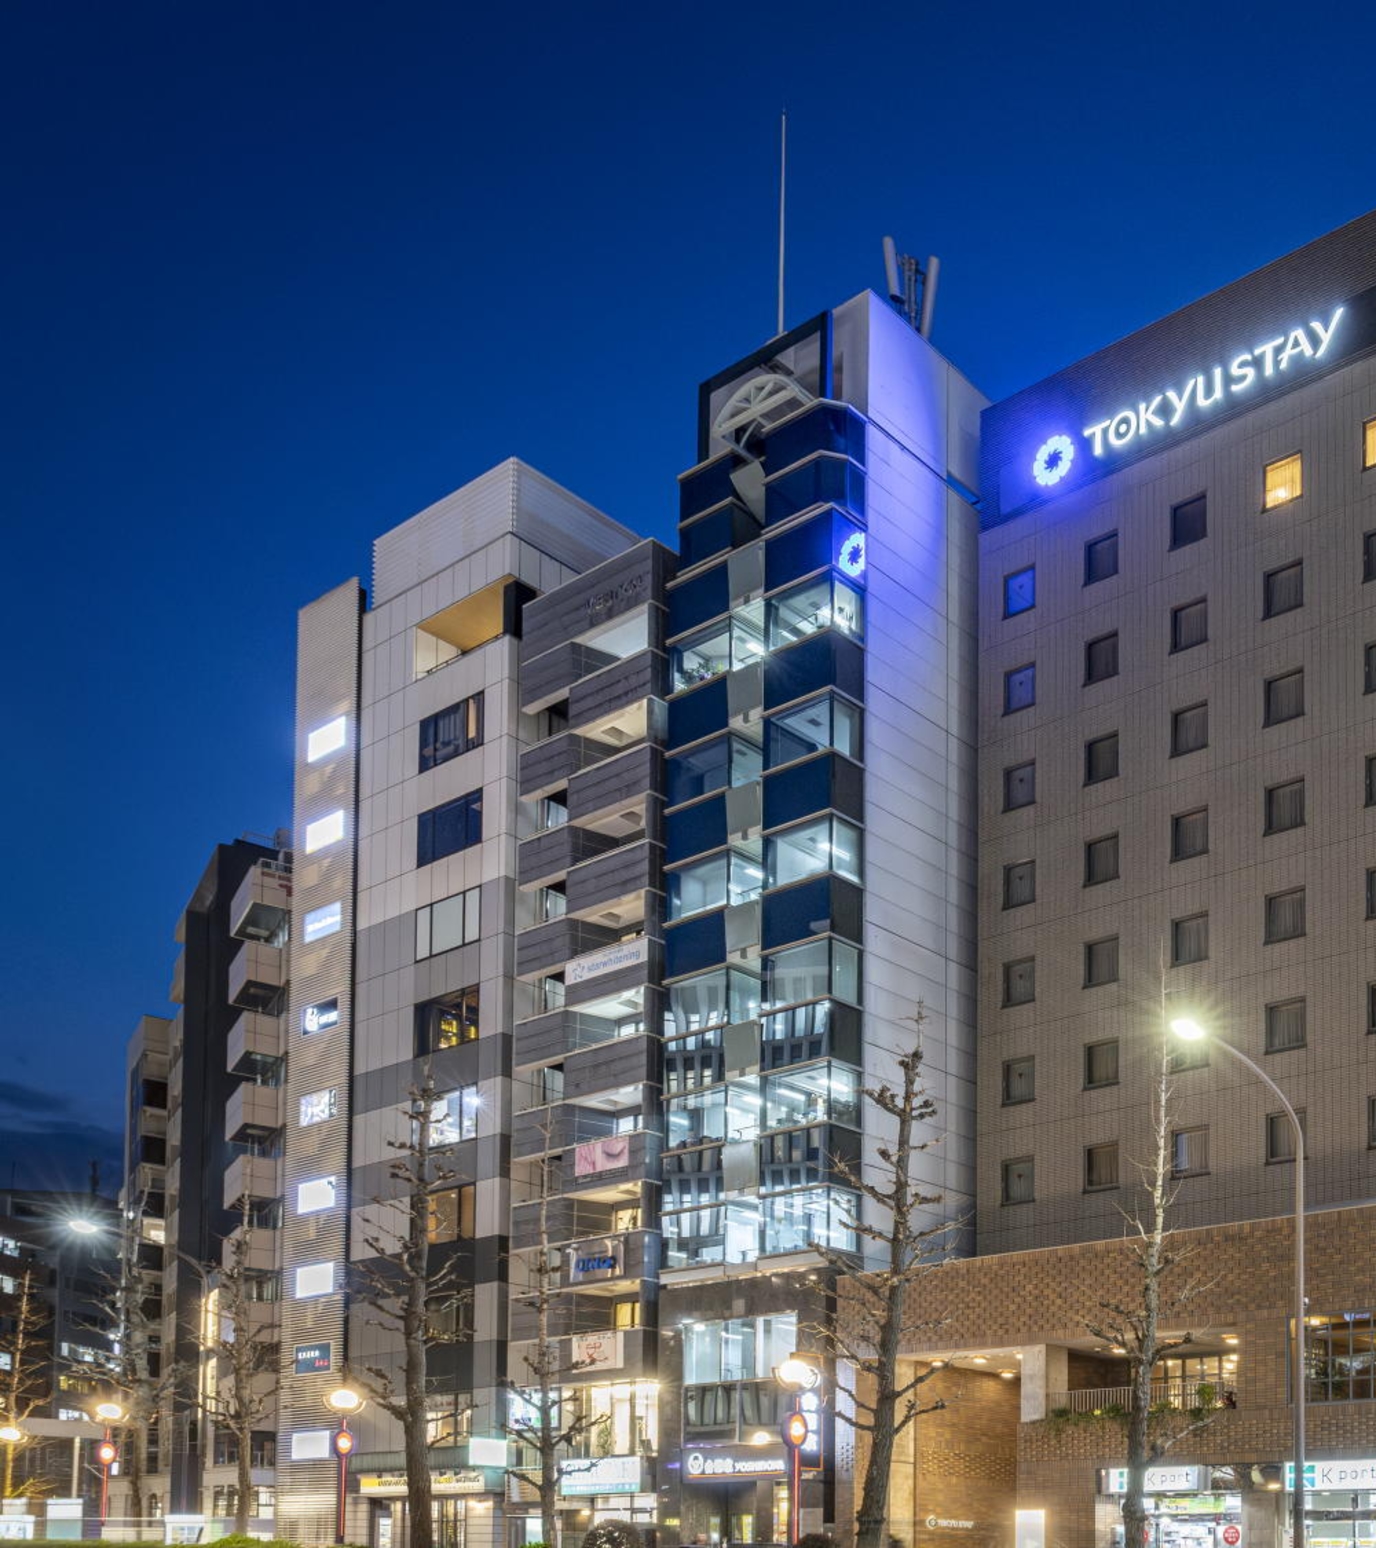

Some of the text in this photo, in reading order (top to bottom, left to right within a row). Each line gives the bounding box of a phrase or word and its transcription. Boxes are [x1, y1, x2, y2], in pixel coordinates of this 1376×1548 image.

[1083, 307, 1344, 457] TOKYU STAY
[1147, 1471, 1190, 1485] K port
[1321, 1466, 1376, 1484] K port
